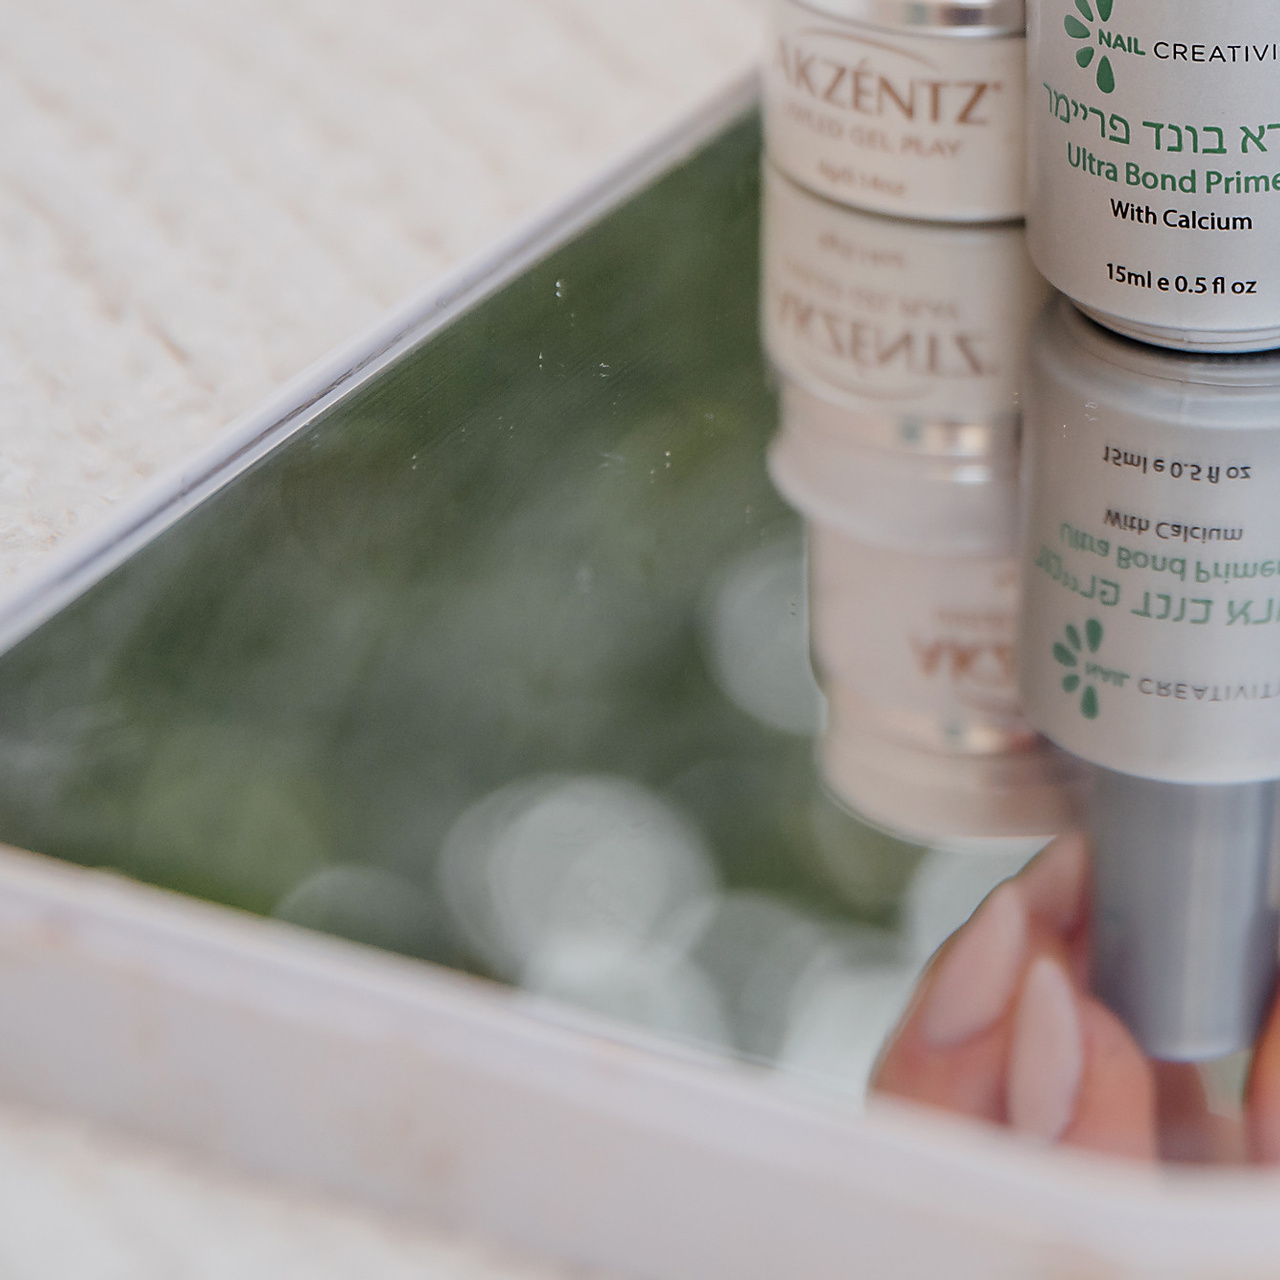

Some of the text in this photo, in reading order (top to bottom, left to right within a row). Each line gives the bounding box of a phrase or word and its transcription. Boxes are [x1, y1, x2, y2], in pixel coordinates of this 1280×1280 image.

[1098, 27, 1146, 56] NAIL
[1043, 82, 1131, 145] פריימר
[1142, 120, 1228, 155] בונד
[1067, 141, 1118, 182] Ultra
[1125, 161, 1196, 194] Bond
[1110, 198, 1253, 231] With Calcium
[1106, 263, 1257, 294] 15ml e 0.5 fl oz
